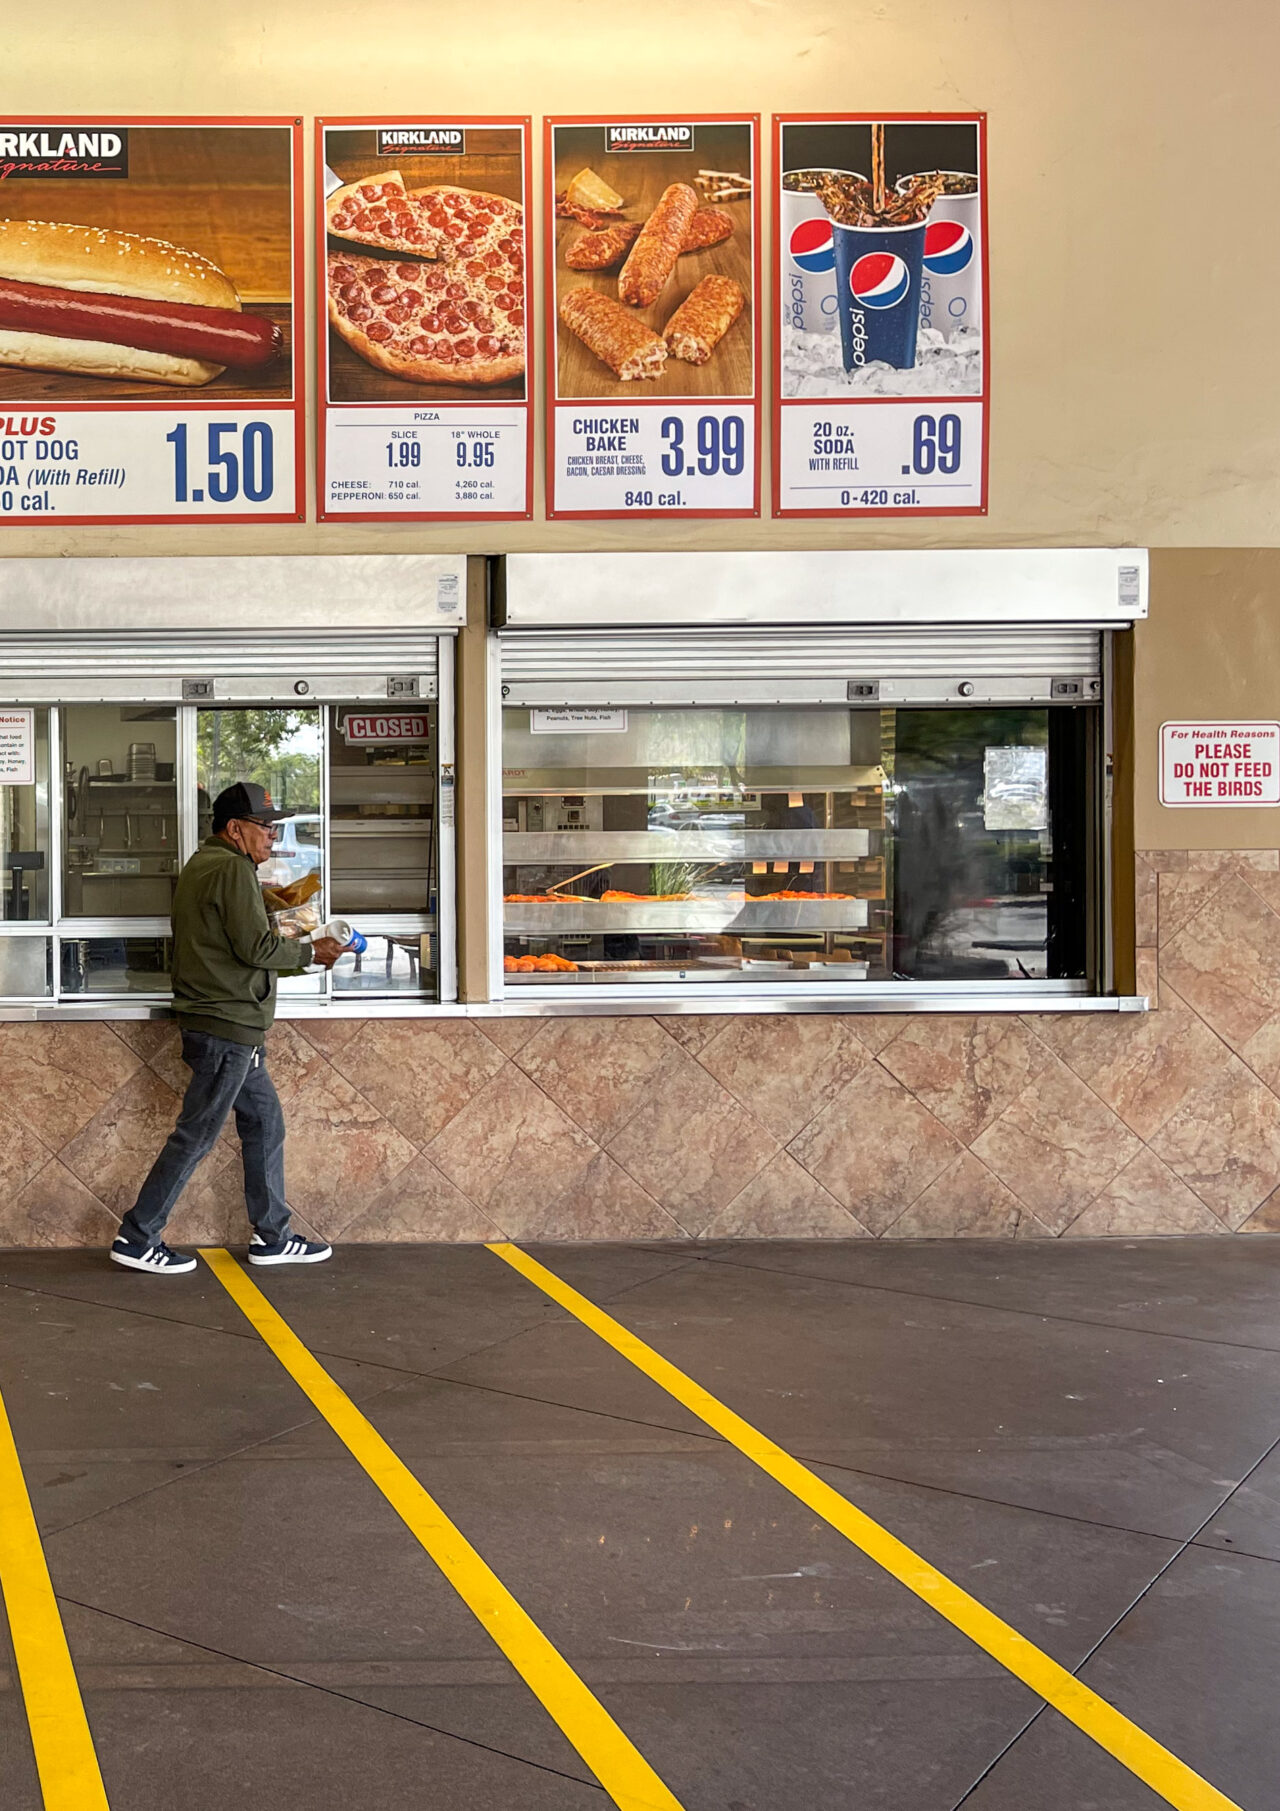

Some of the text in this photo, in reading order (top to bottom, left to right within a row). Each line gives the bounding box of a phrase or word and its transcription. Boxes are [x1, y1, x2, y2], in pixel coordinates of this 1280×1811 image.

[381, 131, 462, 145] KIRKLAND
[610, 127, 690, 141] KIRKLAND
[382, 144, 461, 155] Signature
[611, 140, 690, 152] Signature
[789, 273, 807, 330] pepsi
[849, 307, 869, 367] pepsi
[414, 413, 440, 421] PIZZA
[573, 419, 639, 434] CHICKEN
[813, 422, 854, 437] 20 oz.
[391, 431, 418, 439] SLICE
[467, 431, 500, 439] WHOLE
[35, 440, 79, 461] DOG
[586, 436, 626, 451] BAKE
[661, 416, 745, 476] 3.99
[813, 439, 855, 454] SODA
[901, 414, 961, 475] .69
[166, 421, 274, 502] 1.50
[386, 442, 495, 467] 1.99 9.95
[567, 455, 645, 466] CHICKEN BREAST, CHEESE,
[567, 465, 646, 477] BACON, CAESAR DRESSING
[809, 457, 859, 470] WITH REFILL
[27, 468, 72, 488] (With
[76, 468, 126, 488] Refill)
[331, 481, 495, 489] CHEESE: 710 cal. 4,260 cal.
[21, 492, 56, 512] cal.
[331, 492, 495, 501] PEPPERONI: 650 cal. 3,880 cal.
[625, 491, 686, 506] 840 cal.
[893, 489, 920, 504] cal.
[352, 719, 424, 737] CLOSED
[1171, 730, 1275, 739] For Health Reasons
[1195, 744, 1251, 759] PLEASE
[1174, 762, 1272, 778] DO NOT FEED
[1183, 781, 1263, 796] THE BIRDS
